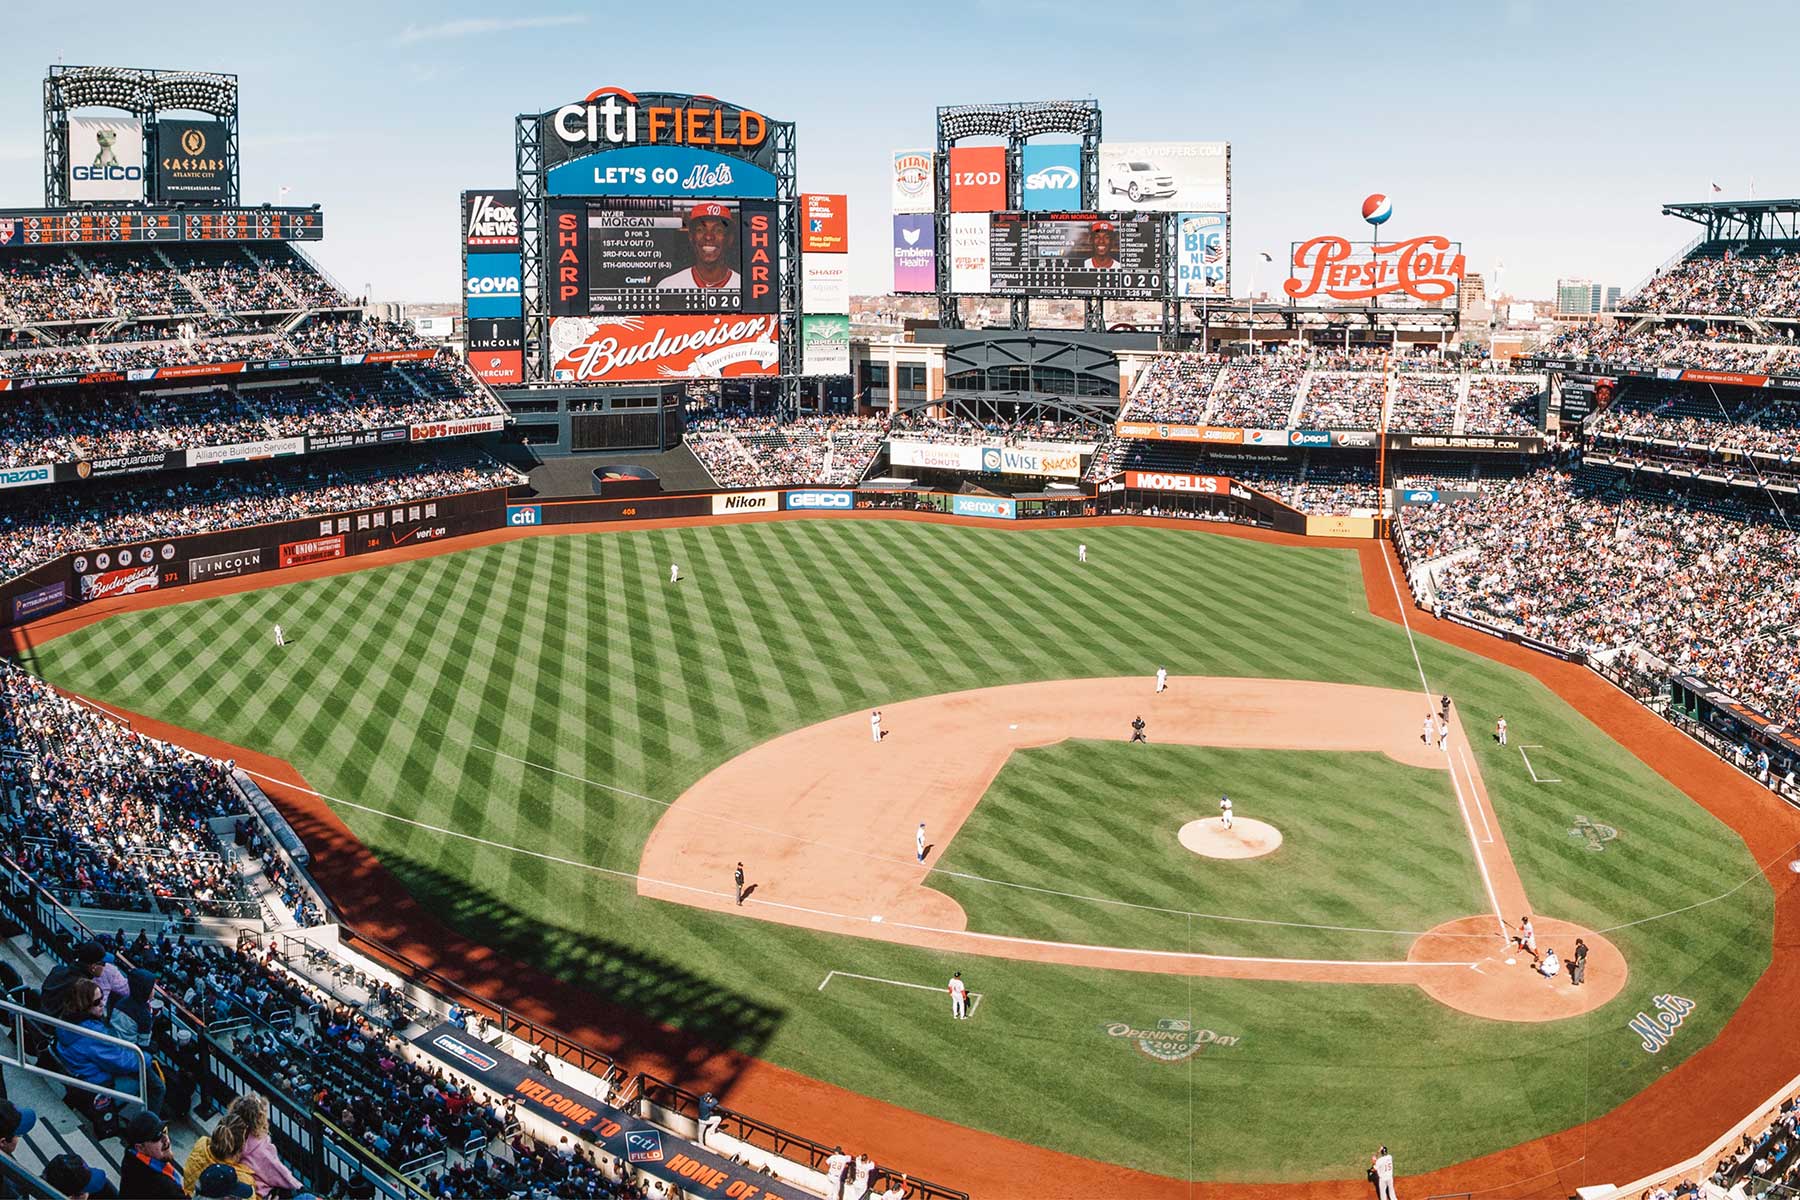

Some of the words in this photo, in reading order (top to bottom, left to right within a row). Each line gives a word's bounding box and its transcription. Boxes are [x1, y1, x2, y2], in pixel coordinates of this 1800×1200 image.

[555, 96, 635, 142] citi
[649, 107, 766, 145] FIELD
[163, 158, 224, 170] CAESARS
[896, 157, 929, 170] TITAN
[72, 166, 141, 180] GEICO
[594, 167, 646, 184] LET'S
[651, 167, 679, 183] GO
[682, 163, 733, 189] Mets
[955, 172, 1001, 185] IZOD
[1026, 170, 1077, 190] SNY
[484, 206, 517, 222] FOX
[602, 210, 624, 218] NYJER
[475, 222, 518, 236] NEWS
[601, 217, 655, 228] MORGAN
[558, 214, 579, 301] SHARP
[751, 215, 769, 299] SHARP
[895, 248, 933, 257] Emblem
[900, 258, 929, 267] Health
[467, 277, 519, 294] GOYA
[1123, 275, 1131, 287] 0
[1138, 275, 1145, 287] 2
[1151, 275, 1159, 287] 0
[709, 296, 716, 307] 0
[721, 296, 728, 307] 2
[732, 296, 740, 307] 0
[471, 340, 520, 348] LINCOLN
[565, 316, 766, 380] Budweiser
[478, 369, 514, 377] MERCURY
[412, 424, 447, 439] BOB'S
[448, 422, 491, 435] FURNITURE
[1119, 426, 1155, 435] SUBWAY
[1203, 430, 1240, 440] SUBWAY
[1304, 434, 1329, 444] pepsi
[195, 449, 228, 460] Alliance
[229, 445, 262, 459] Building
[263, 441, 296, 453] Services
[92, 453, 165, 469] superguarantee
[924, 459, 960, 467] DONUTS
[1004, 453, 1039, 469] WISE
[1040, 455, 1077, 472] SNACKS
[0, 469, 48, 484] mazda
[1137, 473, 1217, 493] MODELL'S
[725, 495, 766, 509] Nikon
[789, 493, 850, 508] GEICO
[959, 501, 995, 513] xerox
[512, 511, 535, 525] citi
[416, 527, 446, 539] verizon
[295, 542, 318, 555] UNION
[75, 560, 85, 569] 37
[99, 557, 106, 565] 14
[122, 554, 129, 562] 41
[198, 554, 261, 573] LINCOLN
[90, 564, 159, 599] Budweiser
[164, 572, 178, 582] 371
[1629, 994, 1696, 1053] Mets
[1105, 1023, 1187, 1042] OPENING
[1192, 1029, 1240, 1047] DAY
[439, 1037, 491, 1069] mets.com
[1155, 1042, 1188, 1051] 2010
[515, 1078, 598, 1126] WELCOME
[592, 1117, 622, 1138] TO
[629, 1134, 657, 1151] citi
[631, 1152, 661, 1160] FIELD
[664, 1153, 730, 1190] HOME
[725, 1180, 760, 1200] OF
